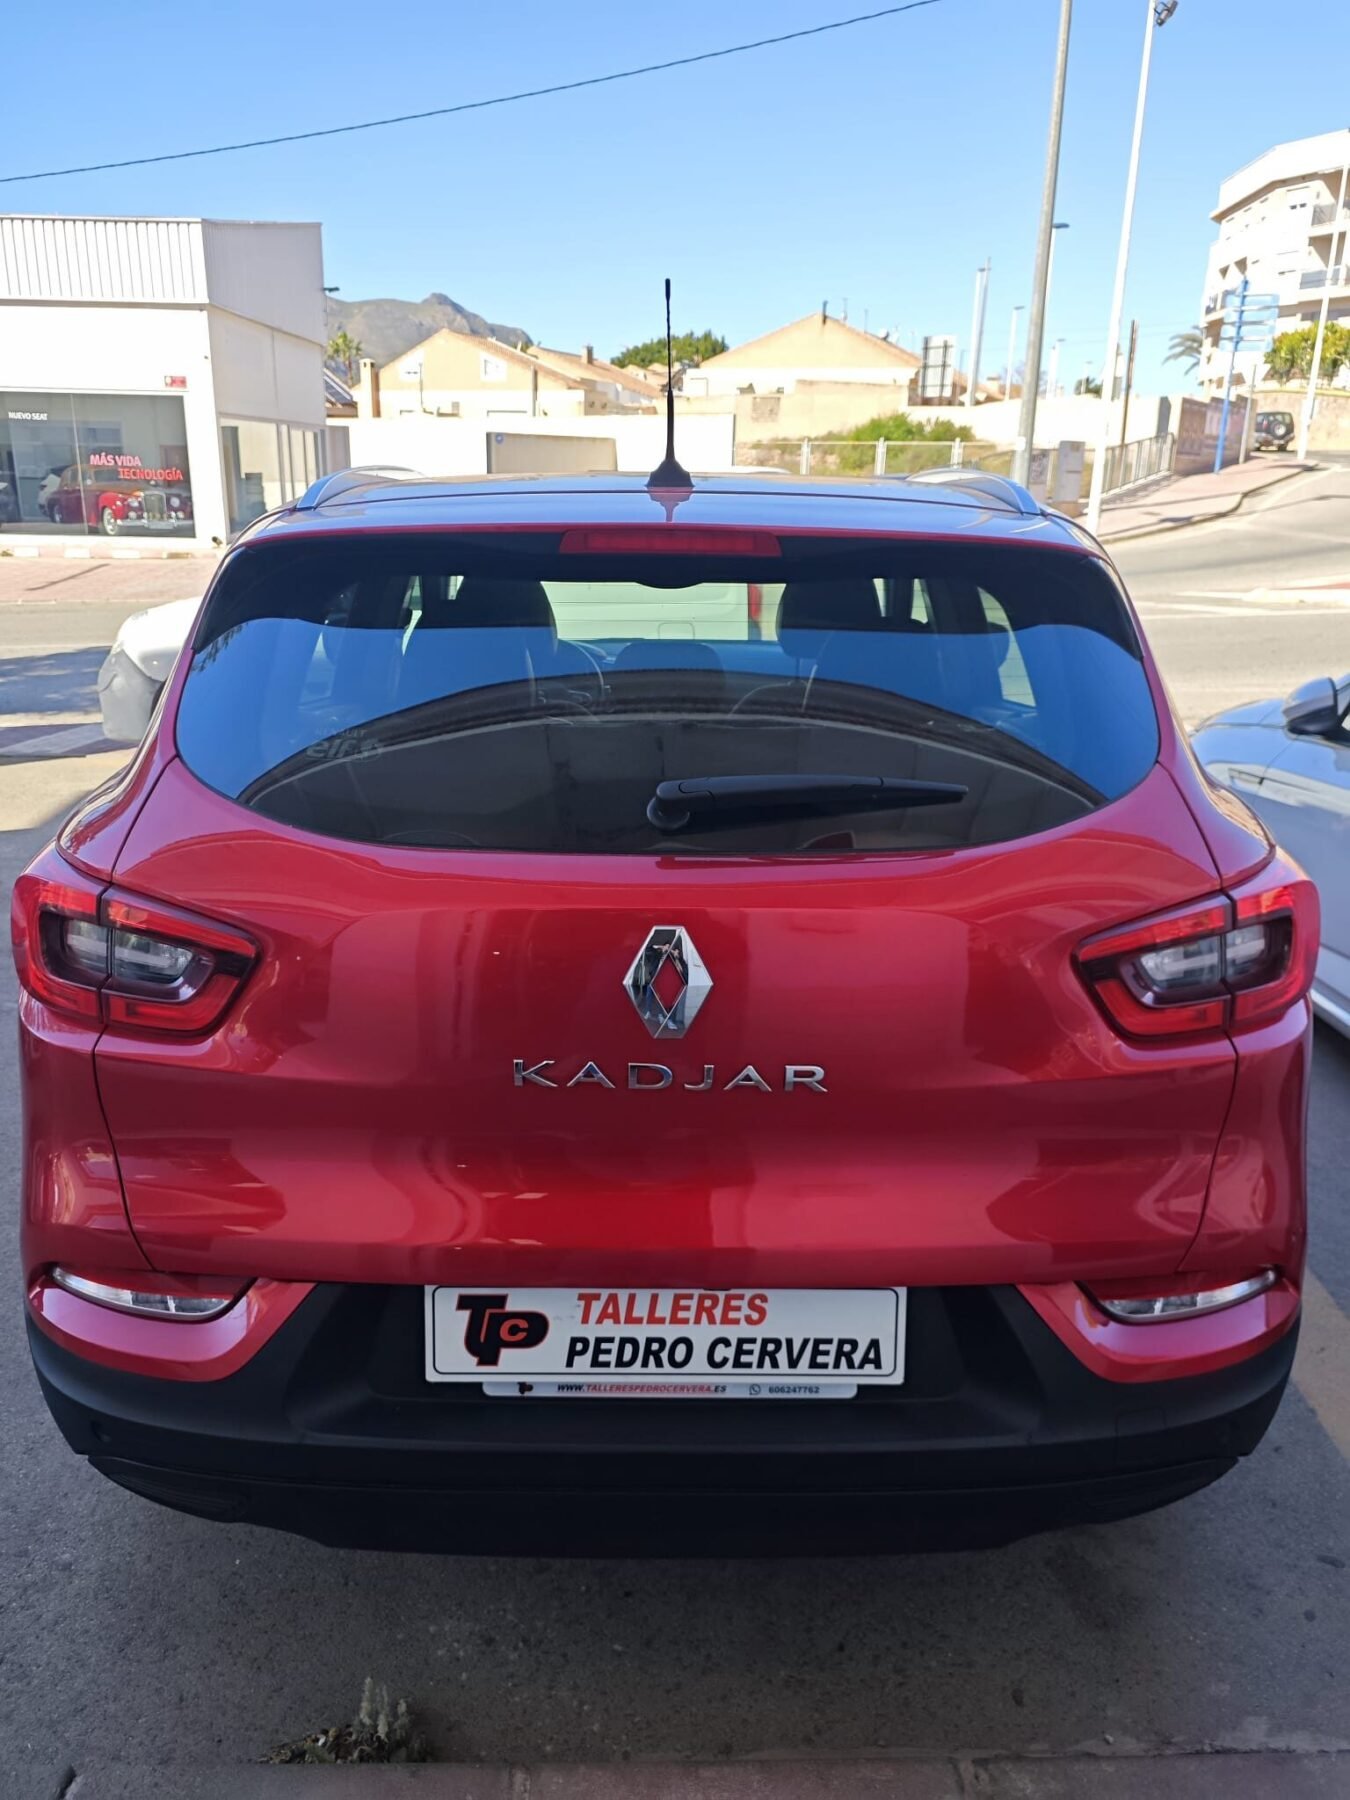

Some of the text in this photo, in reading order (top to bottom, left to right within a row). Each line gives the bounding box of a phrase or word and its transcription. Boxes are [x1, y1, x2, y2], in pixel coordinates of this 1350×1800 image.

[8, 411, 48, 421] NUEVO SEAT
[90, 452, 142, 467] MÁS VIDA
[118, 467, 184, 481] TECNOLOGÍA
[513, 1059, 828, 1093] KADJAR
[577, 1292, 768, 1326] TALLERES
[565, 1336, 883, 1370] PEDRO CERVERA
[557, 1384, 727, 1393] WWW.TALLERESPEDROCERVERA.ES
